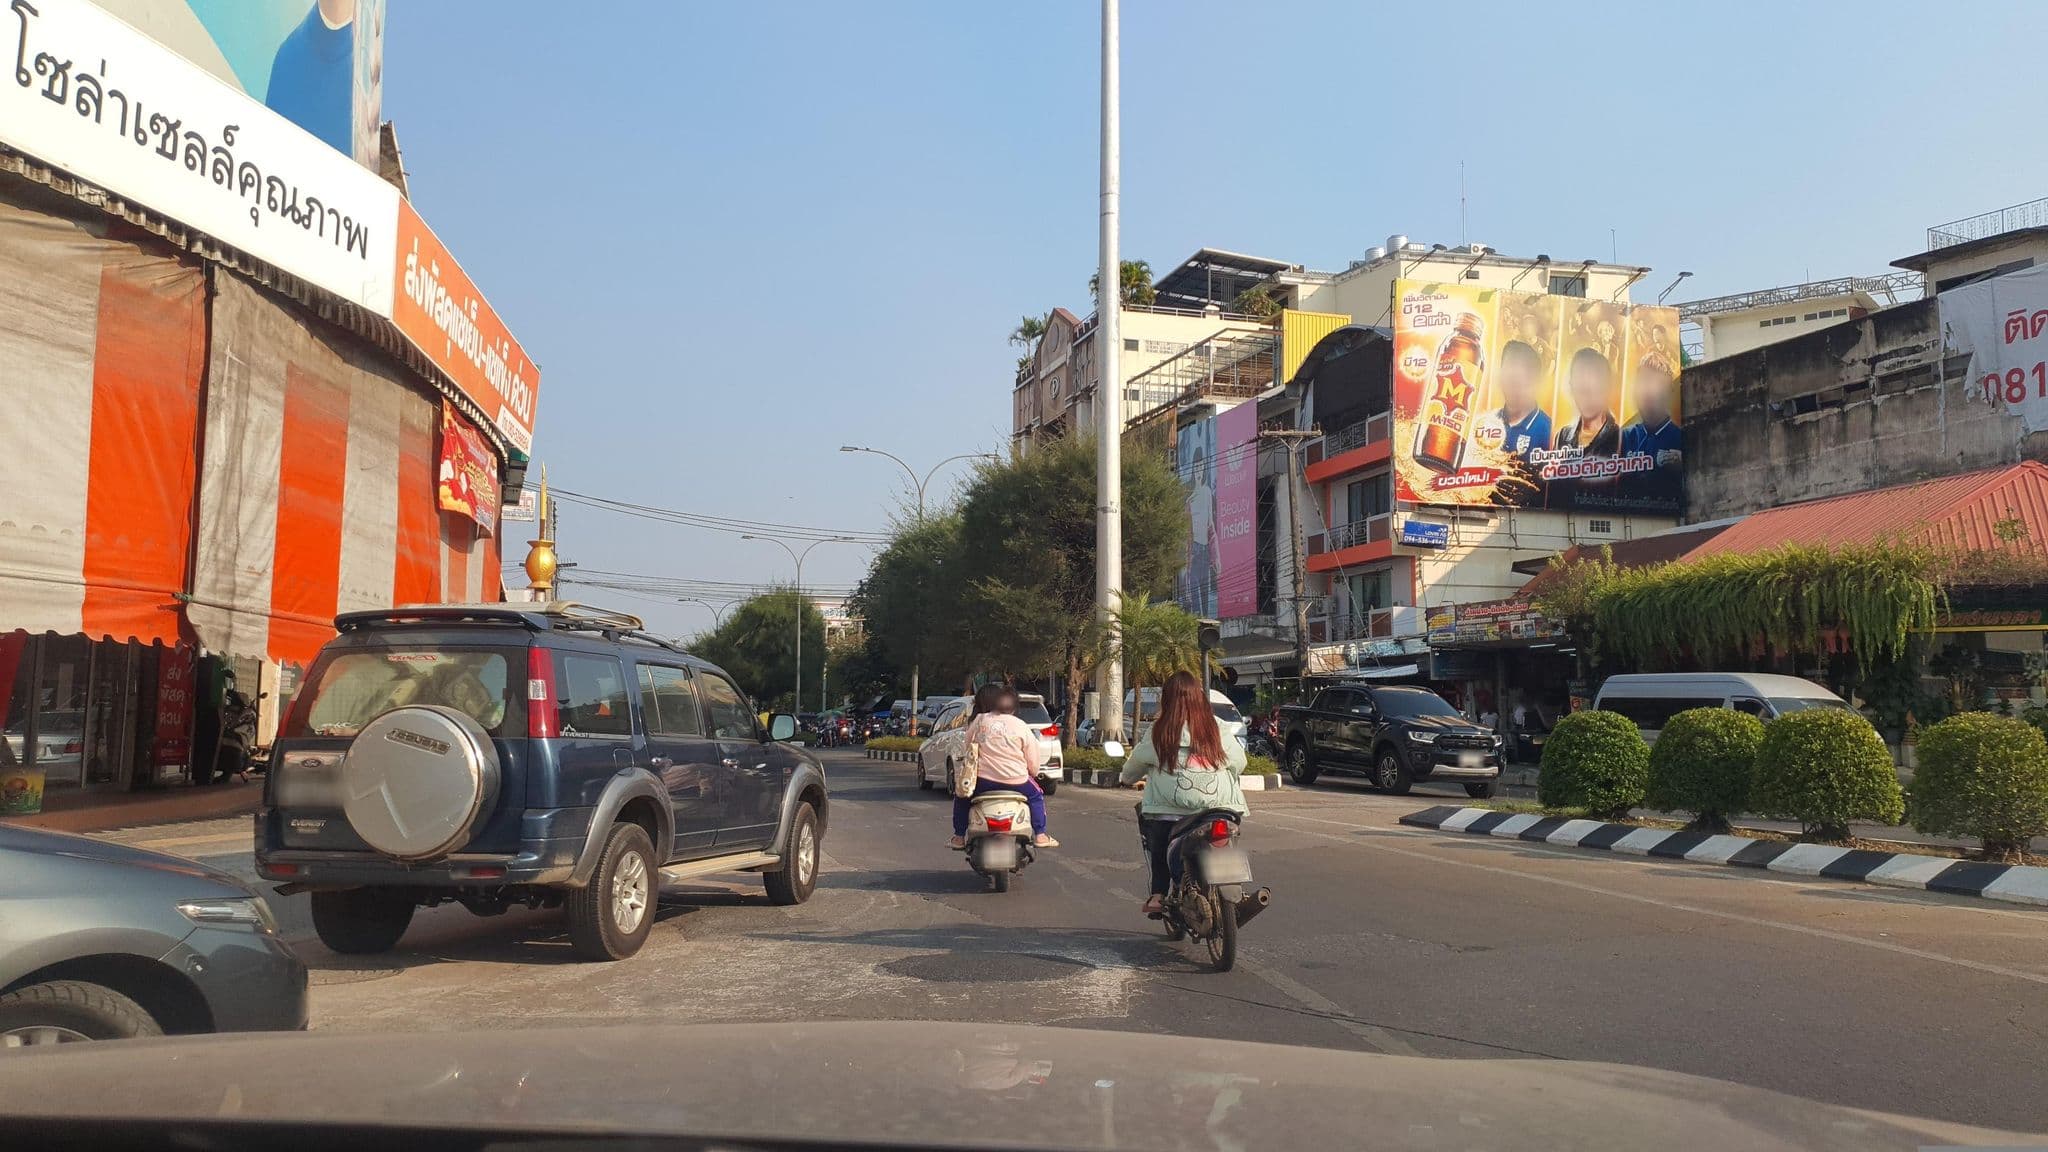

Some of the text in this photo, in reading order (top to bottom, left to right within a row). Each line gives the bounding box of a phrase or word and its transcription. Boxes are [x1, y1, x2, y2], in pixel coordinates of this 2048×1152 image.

[11, 0, 369, 260] โซล่าเซลล์คุณภาพ
[404, 237, 511, 401] ส่งพัสดุแช่เย็น-แช่แข็ง
[511, 360, 533, 424] ด่วน
[1440, 377, 1467, 407] M
[1531, 446, 1583, 463] เป็นคนใหม่
[1543, 454, 1653, 479] ต้องดีกว่าเก่า
[1220, 498, 1250, 517] Beauty
[1220, 517, 1250, 540] Inside
[167, 663, 182, 681] ส่ง
